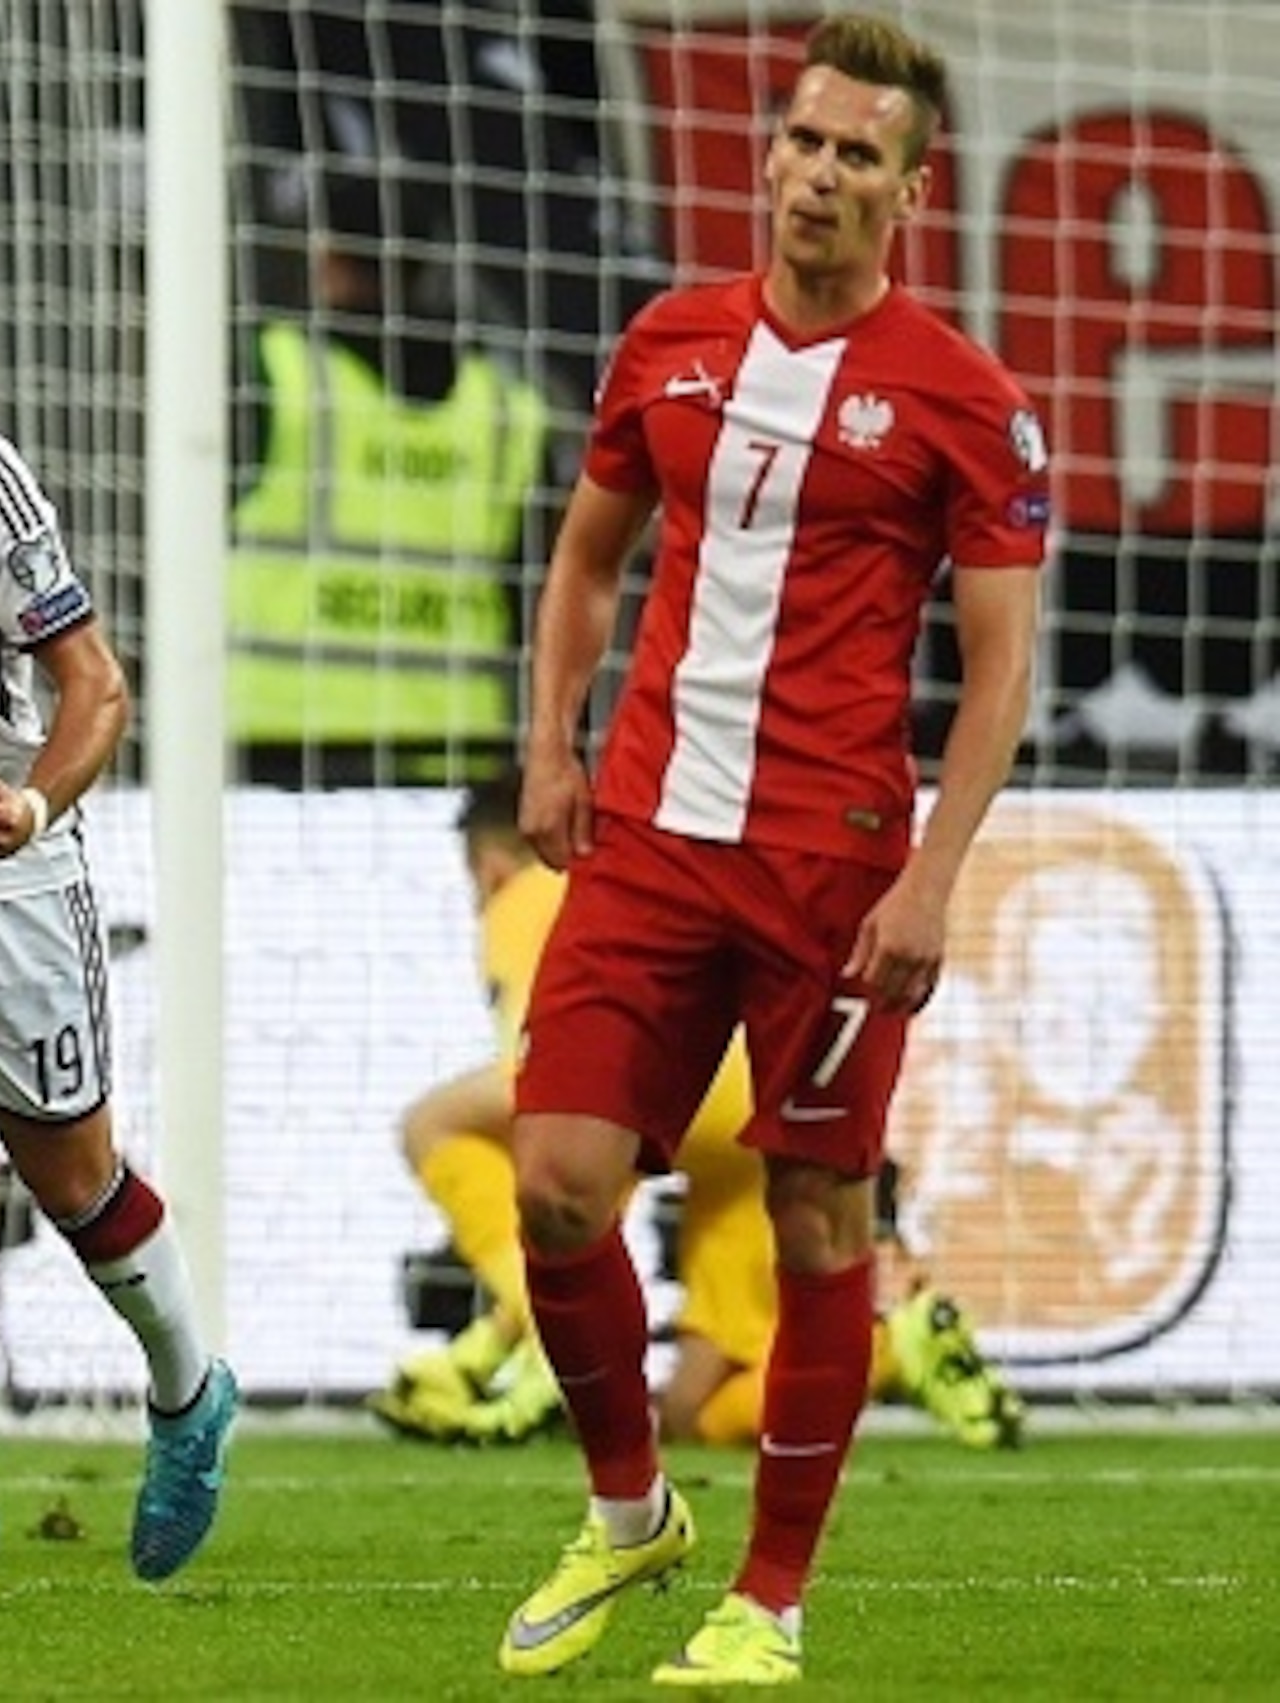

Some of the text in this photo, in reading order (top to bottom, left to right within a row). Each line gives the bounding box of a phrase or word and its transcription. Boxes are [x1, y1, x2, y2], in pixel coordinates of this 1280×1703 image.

[740, 440, 780, 531] 7
[31, 1024, 84, 1104] 19
[813, 996, 868, 1088] 7
